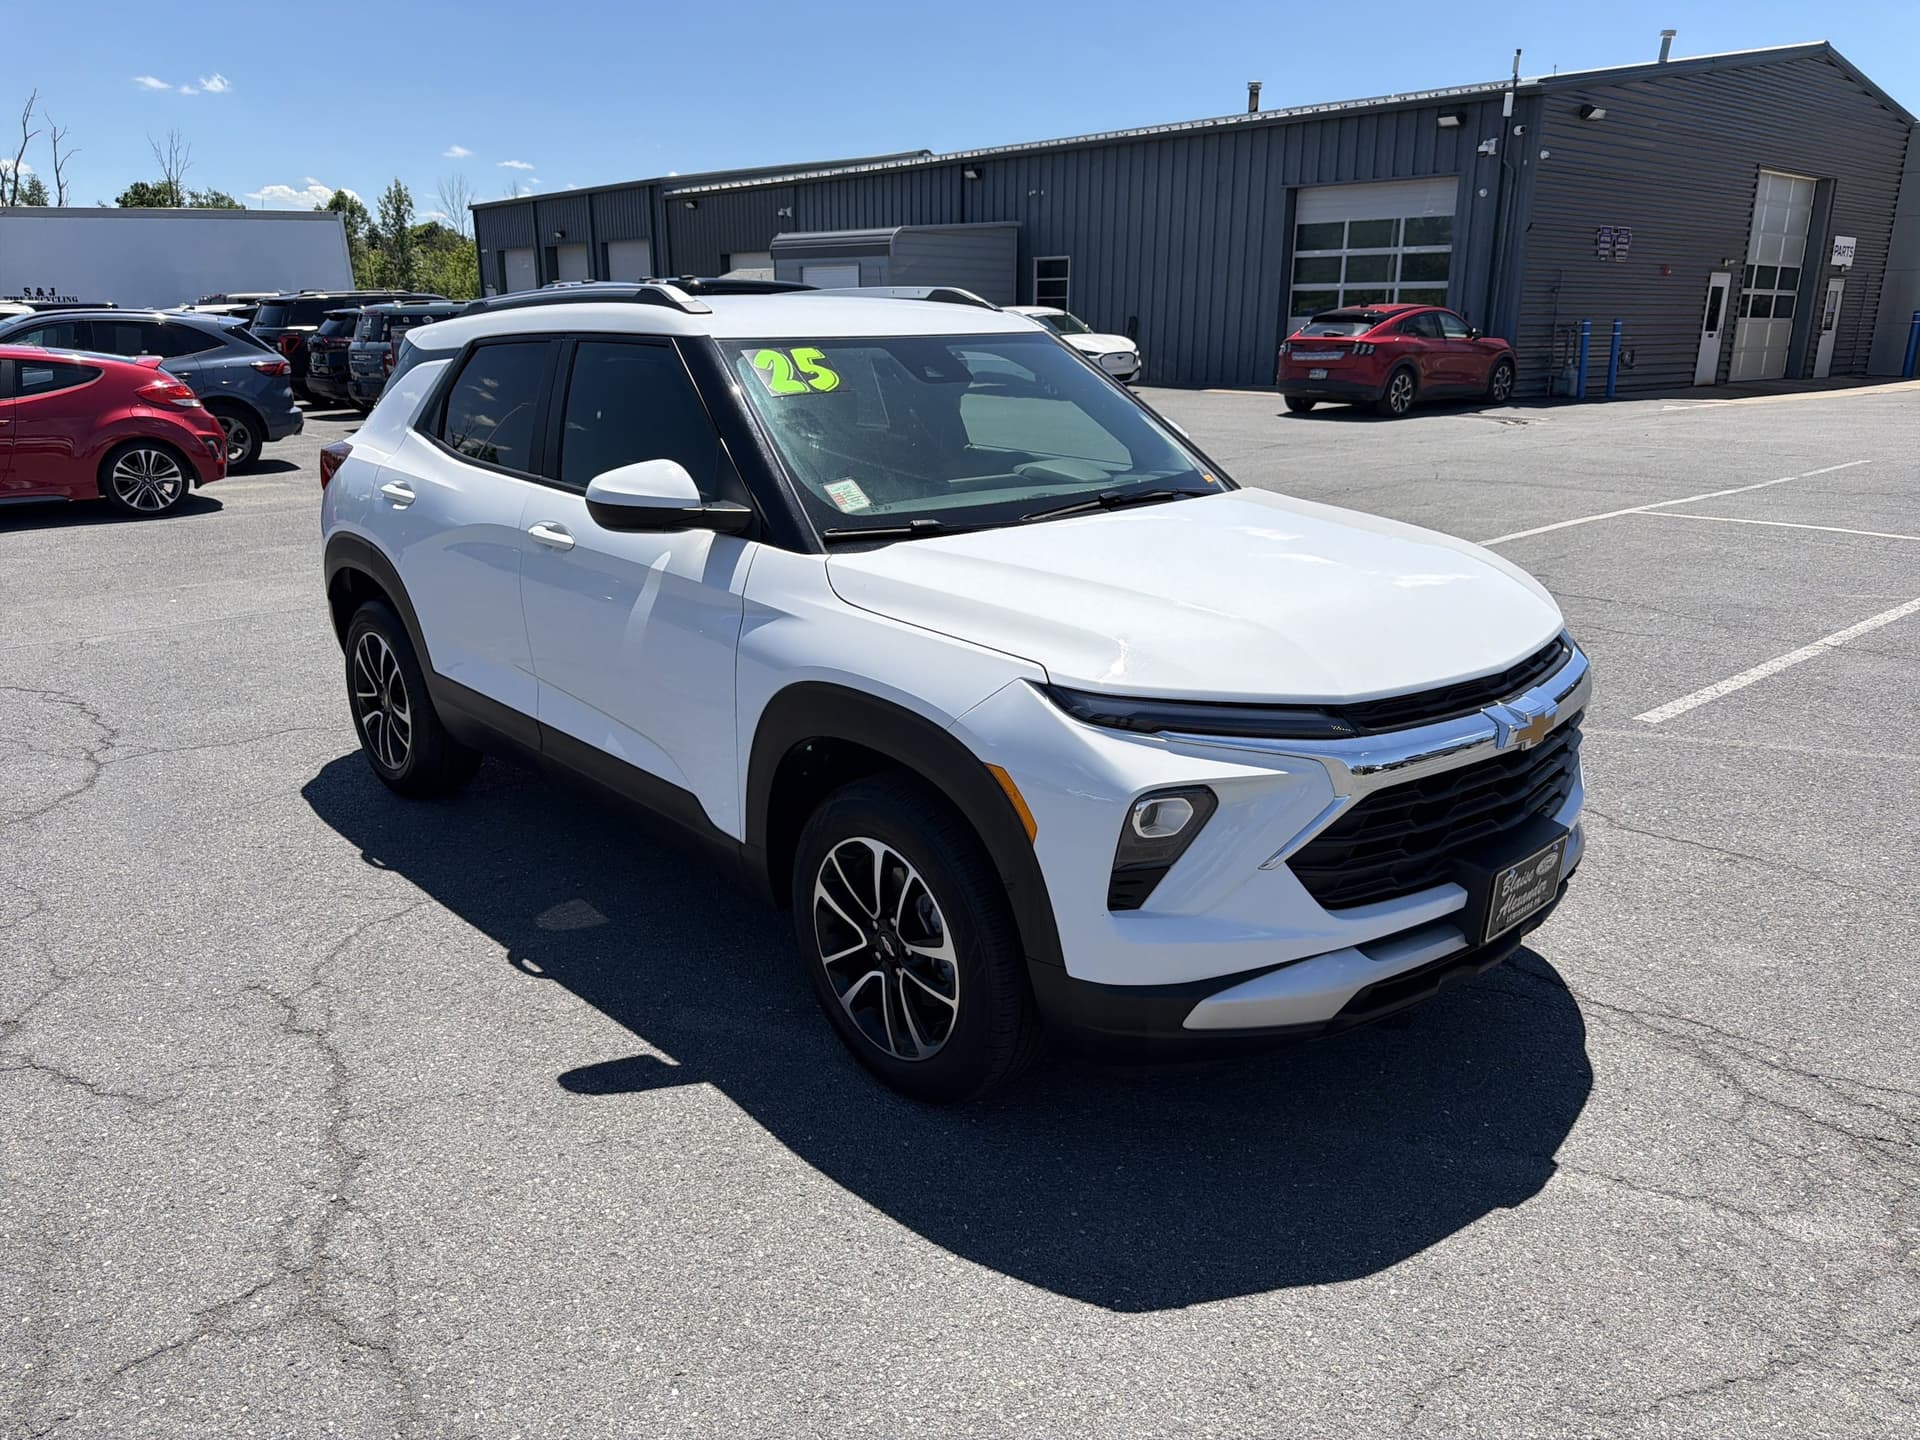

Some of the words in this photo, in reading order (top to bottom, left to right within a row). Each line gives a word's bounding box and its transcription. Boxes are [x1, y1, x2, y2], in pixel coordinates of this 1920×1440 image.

[1834, 244, 1854, 258] PARTS
[23, 287, 31, 296] S
[36, 287, 44, 296] &
[49, 287, 56, 296] J
[753, 347, 840, 394] 25
[1496, 878, 1548, 922] Alexander
